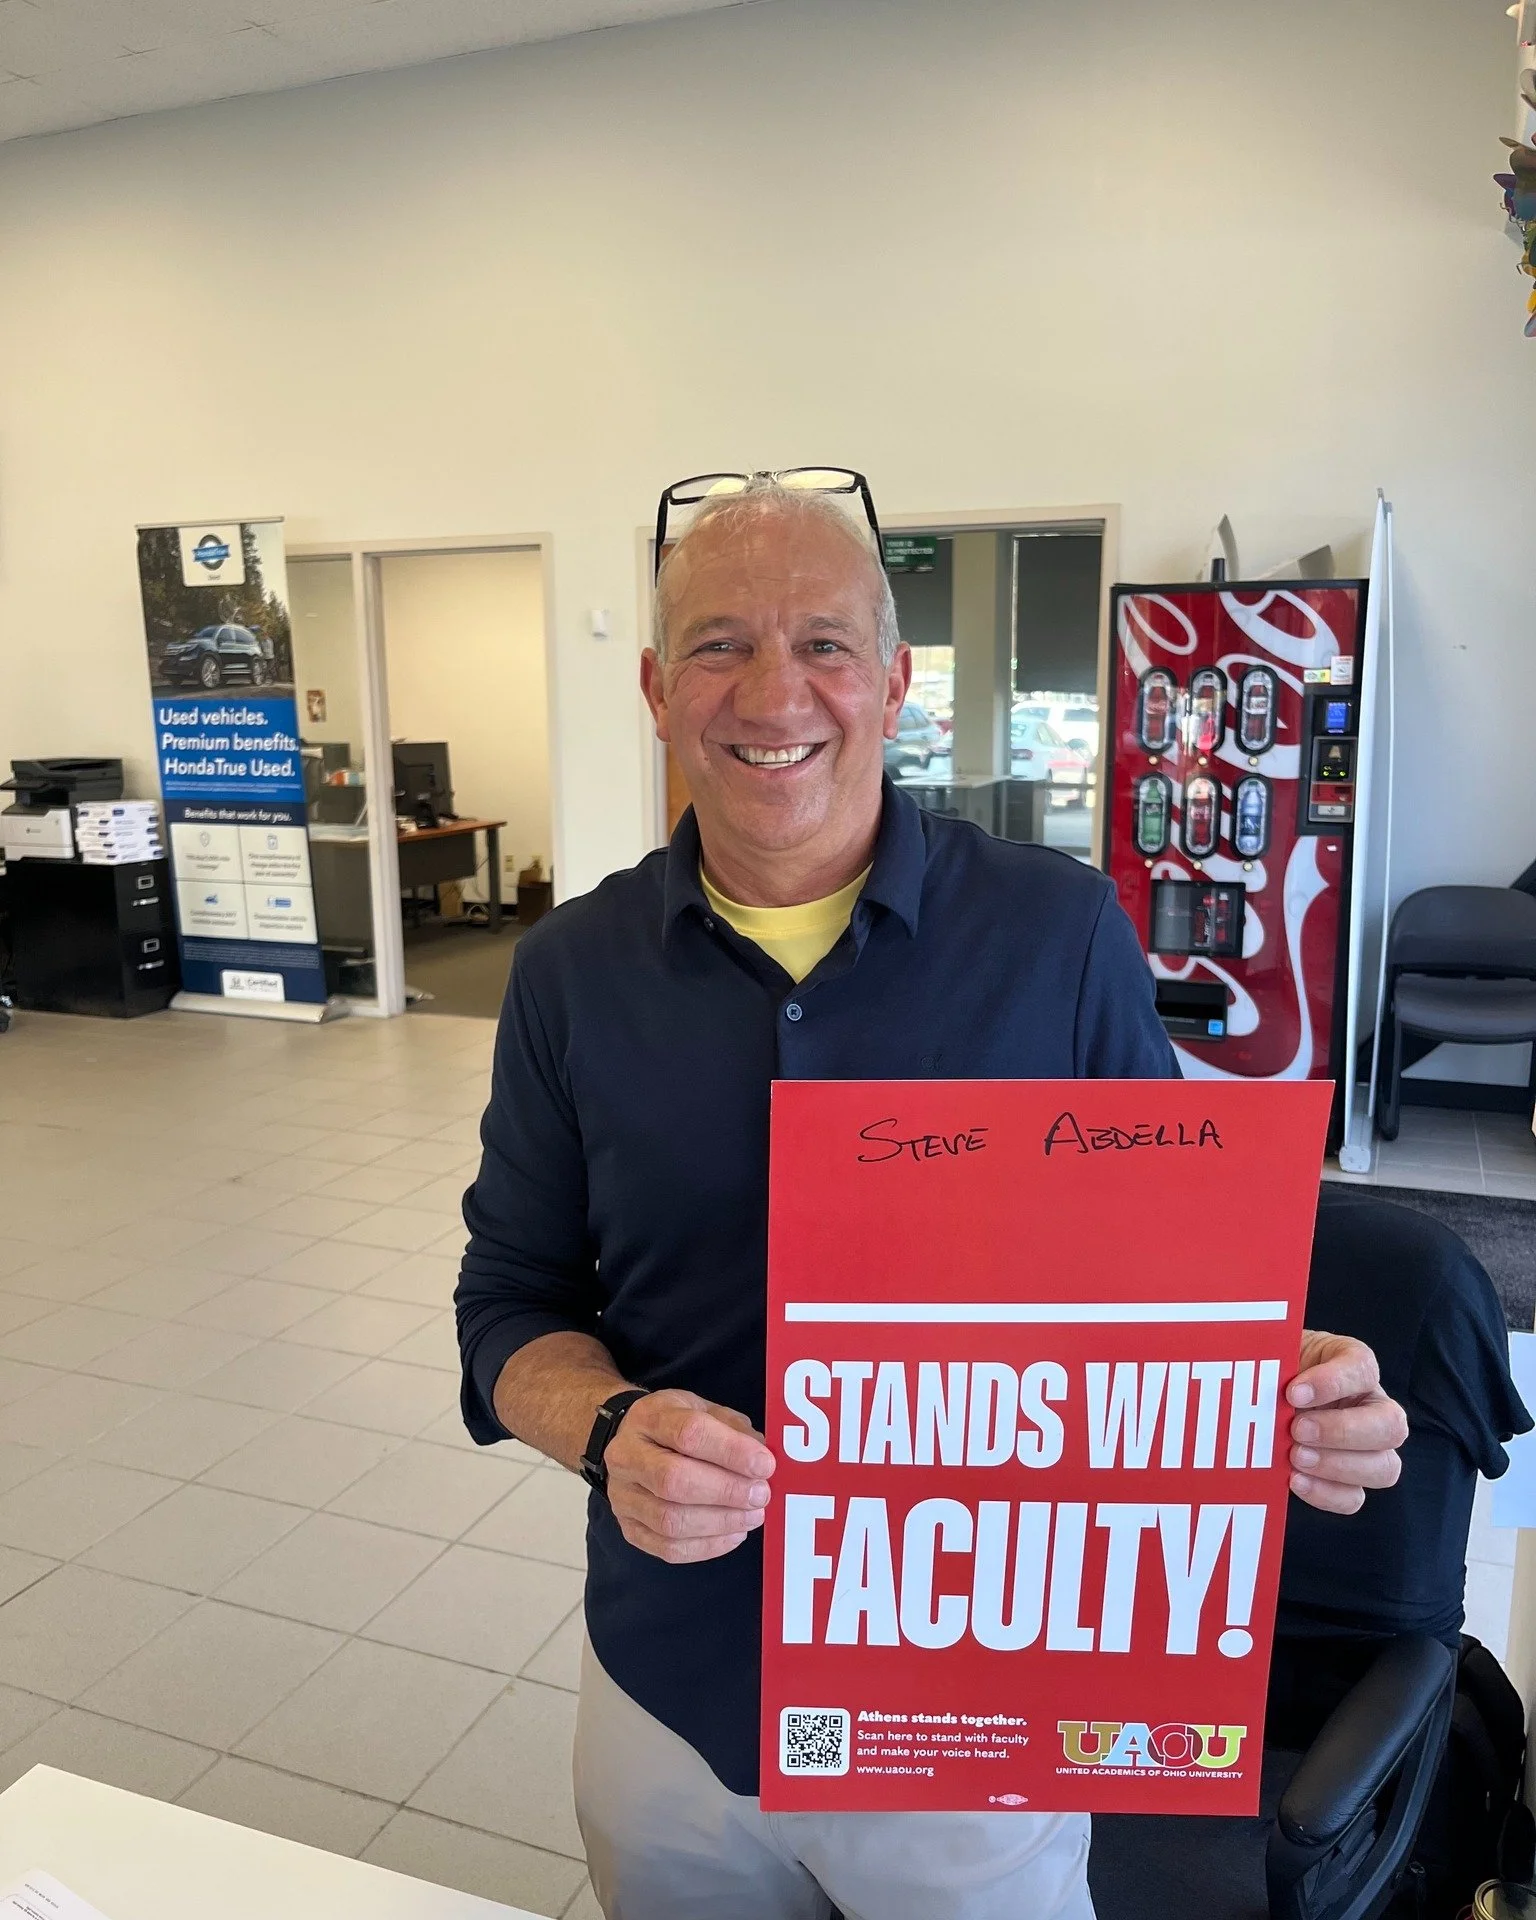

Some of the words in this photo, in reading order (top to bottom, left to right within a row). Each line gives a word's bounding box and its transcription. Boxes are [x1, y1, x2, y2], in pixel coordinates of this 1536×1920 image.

[159, 706, 199, 726] Used
[201, 706, 269, 726] vehicles.
[162, 732, 230, 751] Premium
[233, 731, 300, 752] benefits.
[164, 756, 247, 776] HondaTrue
[251, 757, 296, 777] Used.
[184, 807, 218, 819] Benefits
[218, 808, 236, 820] that
[237, 809, 257, 820] work
[258, 809, 271, 821] for
[272, 812, 292, 823] you.
[782, 1359, 1069, 1469] STANDS
[1085, 1359, 1281, 1469] WITH
[781, 1493, 1268, 1659] FACULTY!
[857, 1710, 908, 1723] Athens
[911, 1712, 957, 1725] stands
[961, 1713, 1028, 1728] together.
[857, 1729, 884, 1741] Scan
[887, 1731, 913, 1742] here
[916, 1732, 928, 1742] to
[931, 1732, 961, 1743] stand
[965, 1732, 988, 1744] with
[991, 1733, 1029, 1746] faculty
[1057, 1720, 1248, 1769] UAOU
[857, 1746, 878, 1757] and
[880, 1747, 910, 1758] make
[913, 1749, 939, 1761] your
[942, 1748, 972, 1759] voice
[974, 1748, 1010, 1760] heard.
[857, 1764, 934, 1777] www.uaou.org
[1055, 1767, 1091, 1776] UNITED
[1091, 1769, 1146, 1777] ACADEMICS
[1148, 1769, 1161, 1777] OF
[1163, 1770, 1187, 1778] OHIO
[1189, 1771, 1244, 1779] UNIVERSITY
